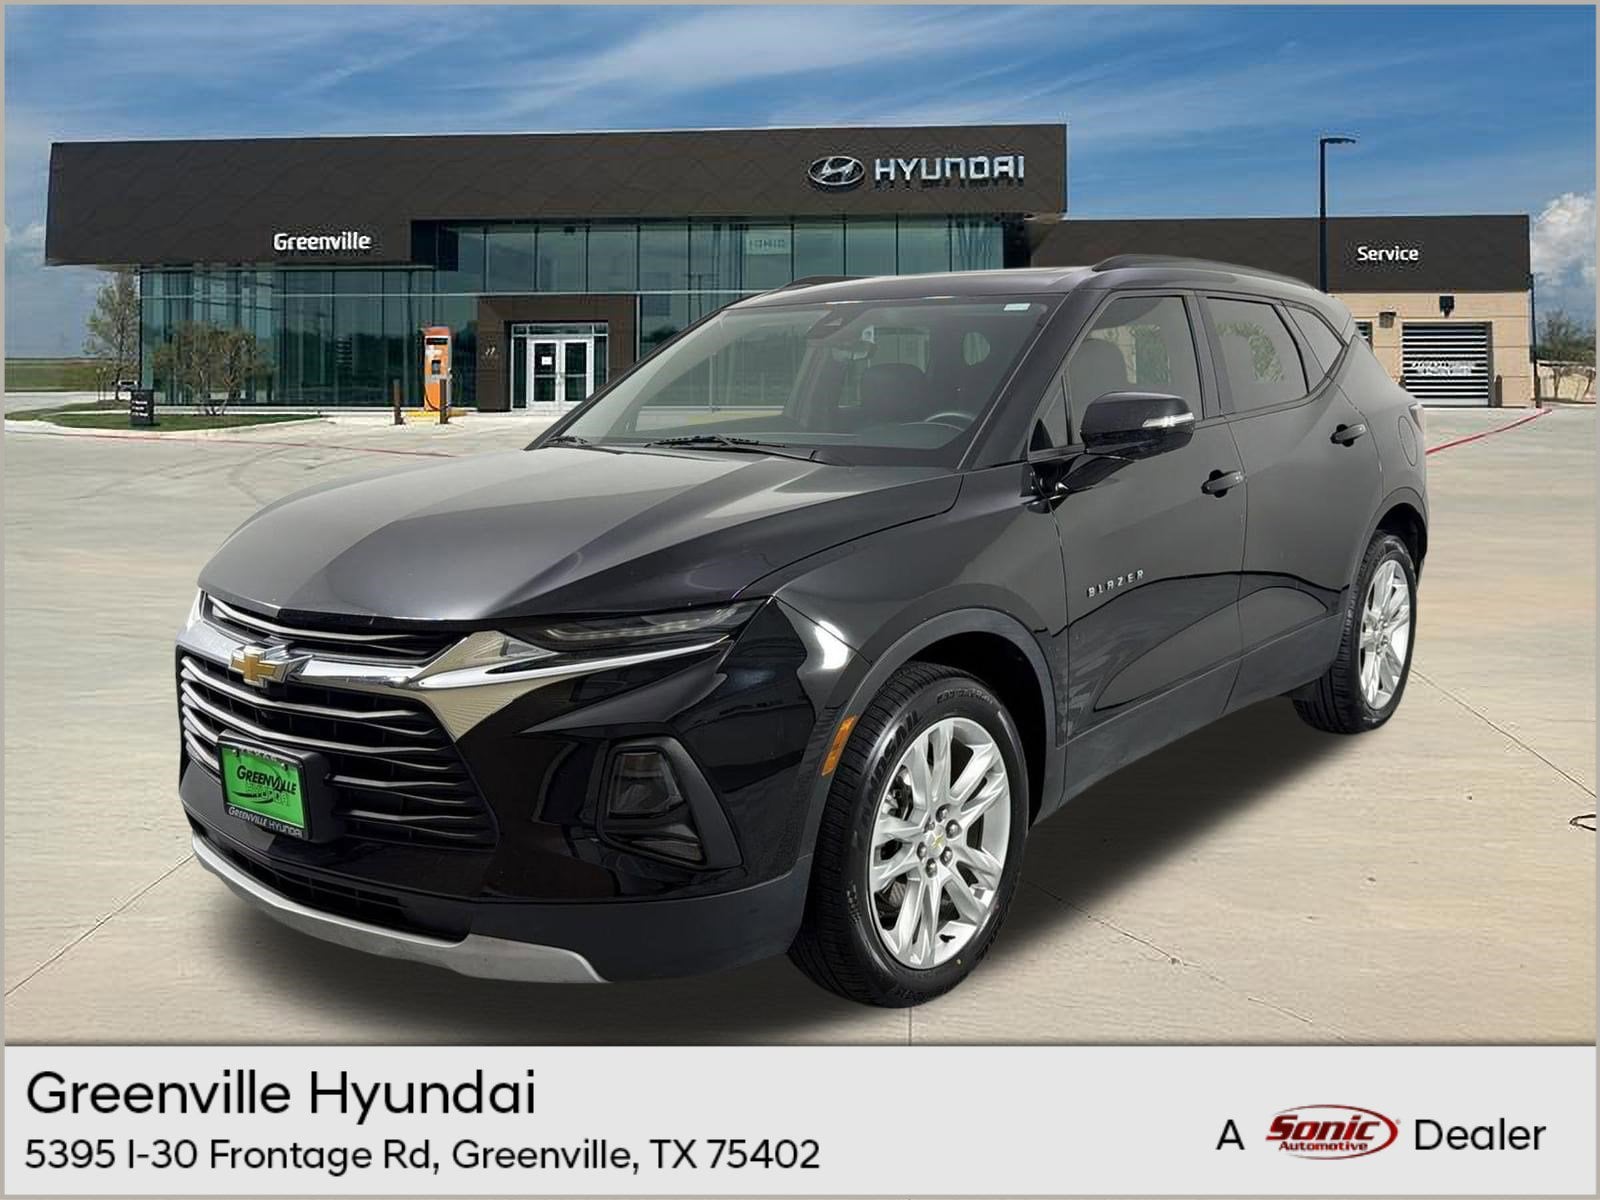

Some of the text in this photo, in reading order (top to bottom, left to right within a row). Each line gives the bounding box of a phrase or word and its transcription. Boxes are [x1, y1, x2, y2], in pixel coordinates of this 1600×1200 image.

[874, 156, 1025, 181] HYUNDAI
[273, 231, 372, 251] Greenville
[1357, 245, 1419, 261] Service
[1087, 569, 1144, 598] BLAZER
[236, 765, 297, 795] GREENVILLE
[228, 806, 304, 839] GREENVILLE HYUNDAI
